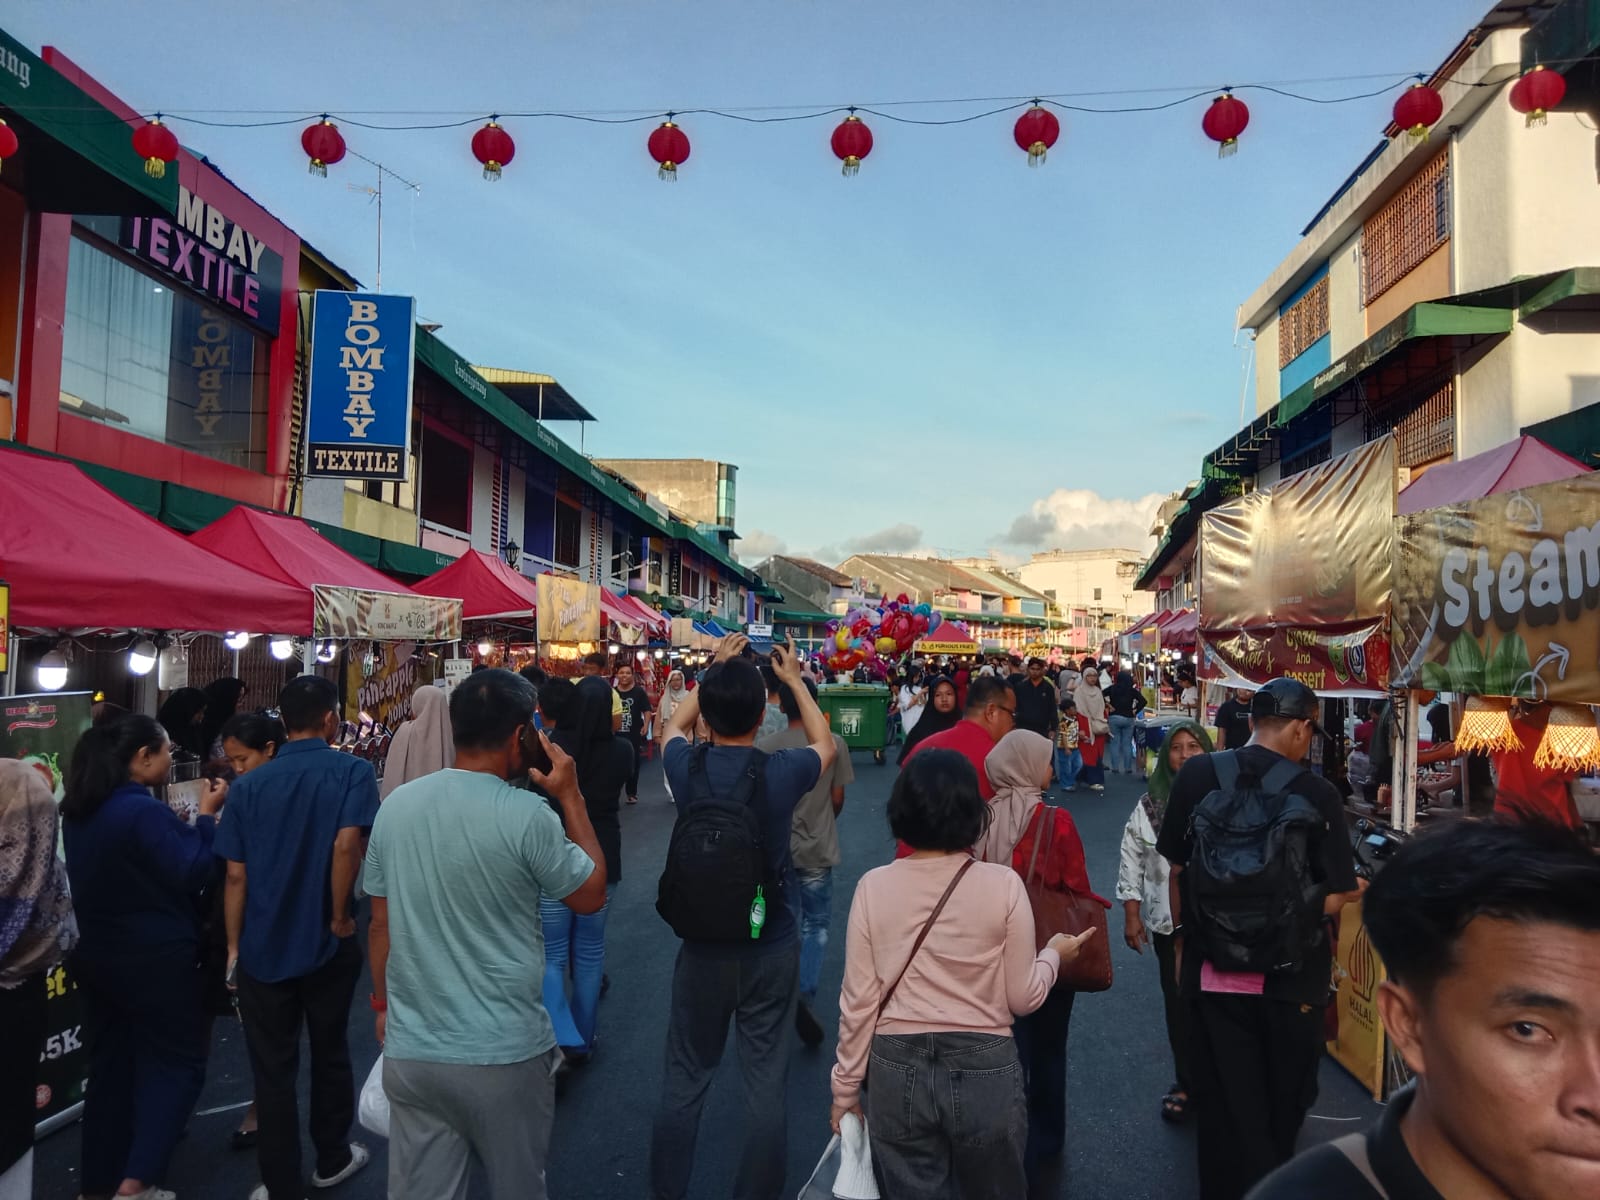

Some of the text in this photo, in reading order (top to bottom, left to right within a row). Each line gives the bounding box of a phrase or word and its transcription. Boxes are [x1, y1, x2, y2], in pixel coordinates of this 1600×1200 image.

[339, 300, 385, 438] BOMBAY
[314, 449, 399, 473] TEXTILE
[1295, 651, 1311, 665] And
[357, 662, 414, 713] Pineapple
